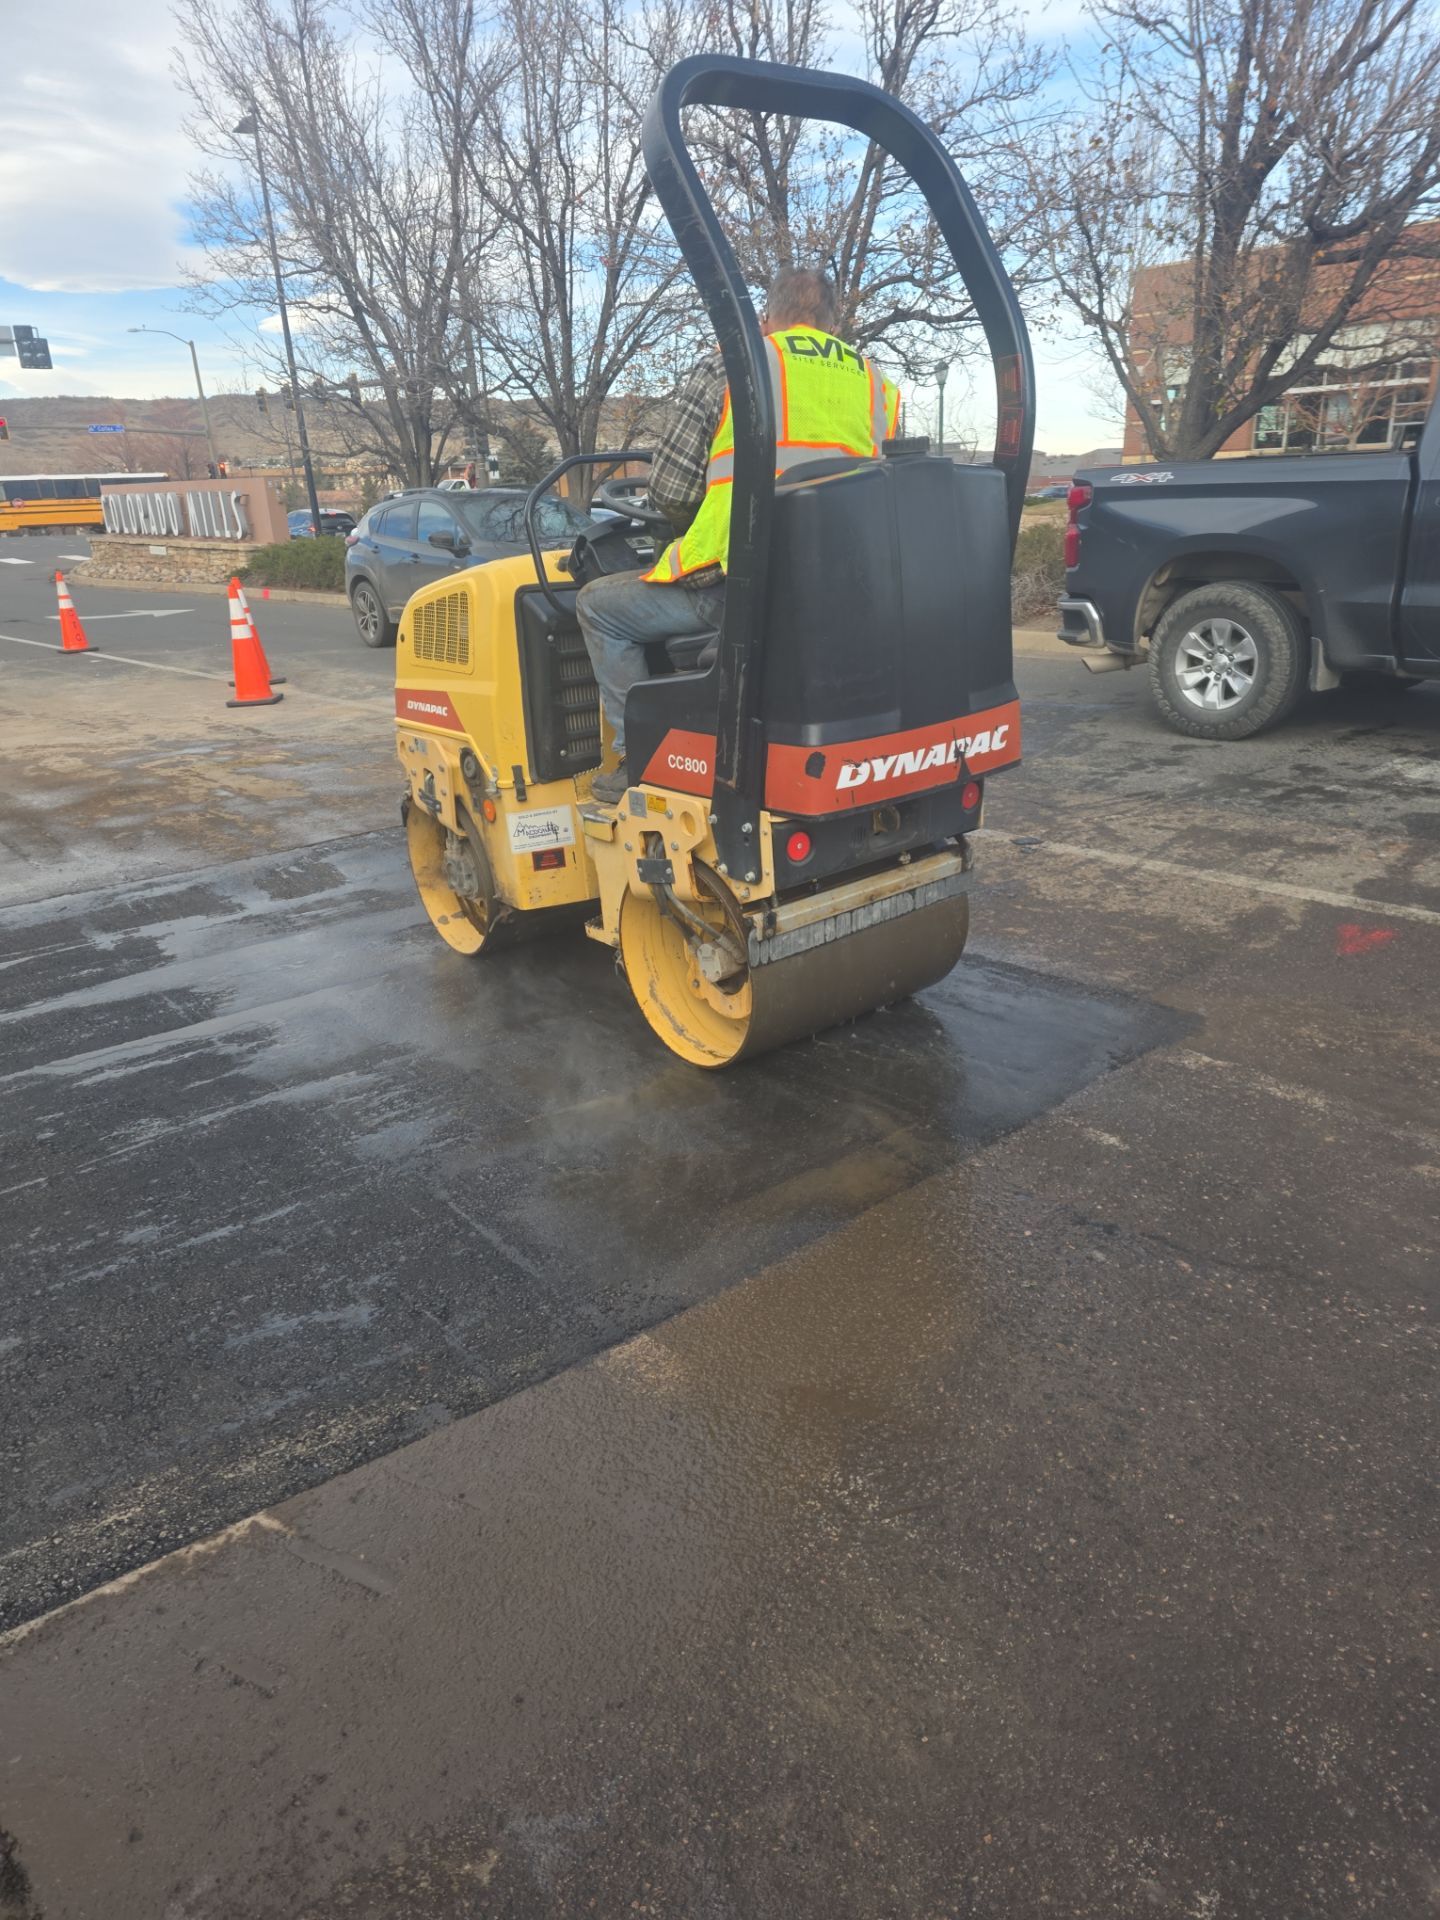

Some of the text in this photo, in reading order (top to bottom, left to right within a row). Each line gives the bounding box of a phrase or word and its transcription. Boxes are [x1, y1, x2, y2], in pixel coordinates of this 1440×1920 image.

[101, 490, 244, 540] COLORADO MILLS
[407, 699, 448, 717] DYNAPAC
[668, 754, 708, 775] CC800
[836, 724, 1010, 790] DYNAPAC
